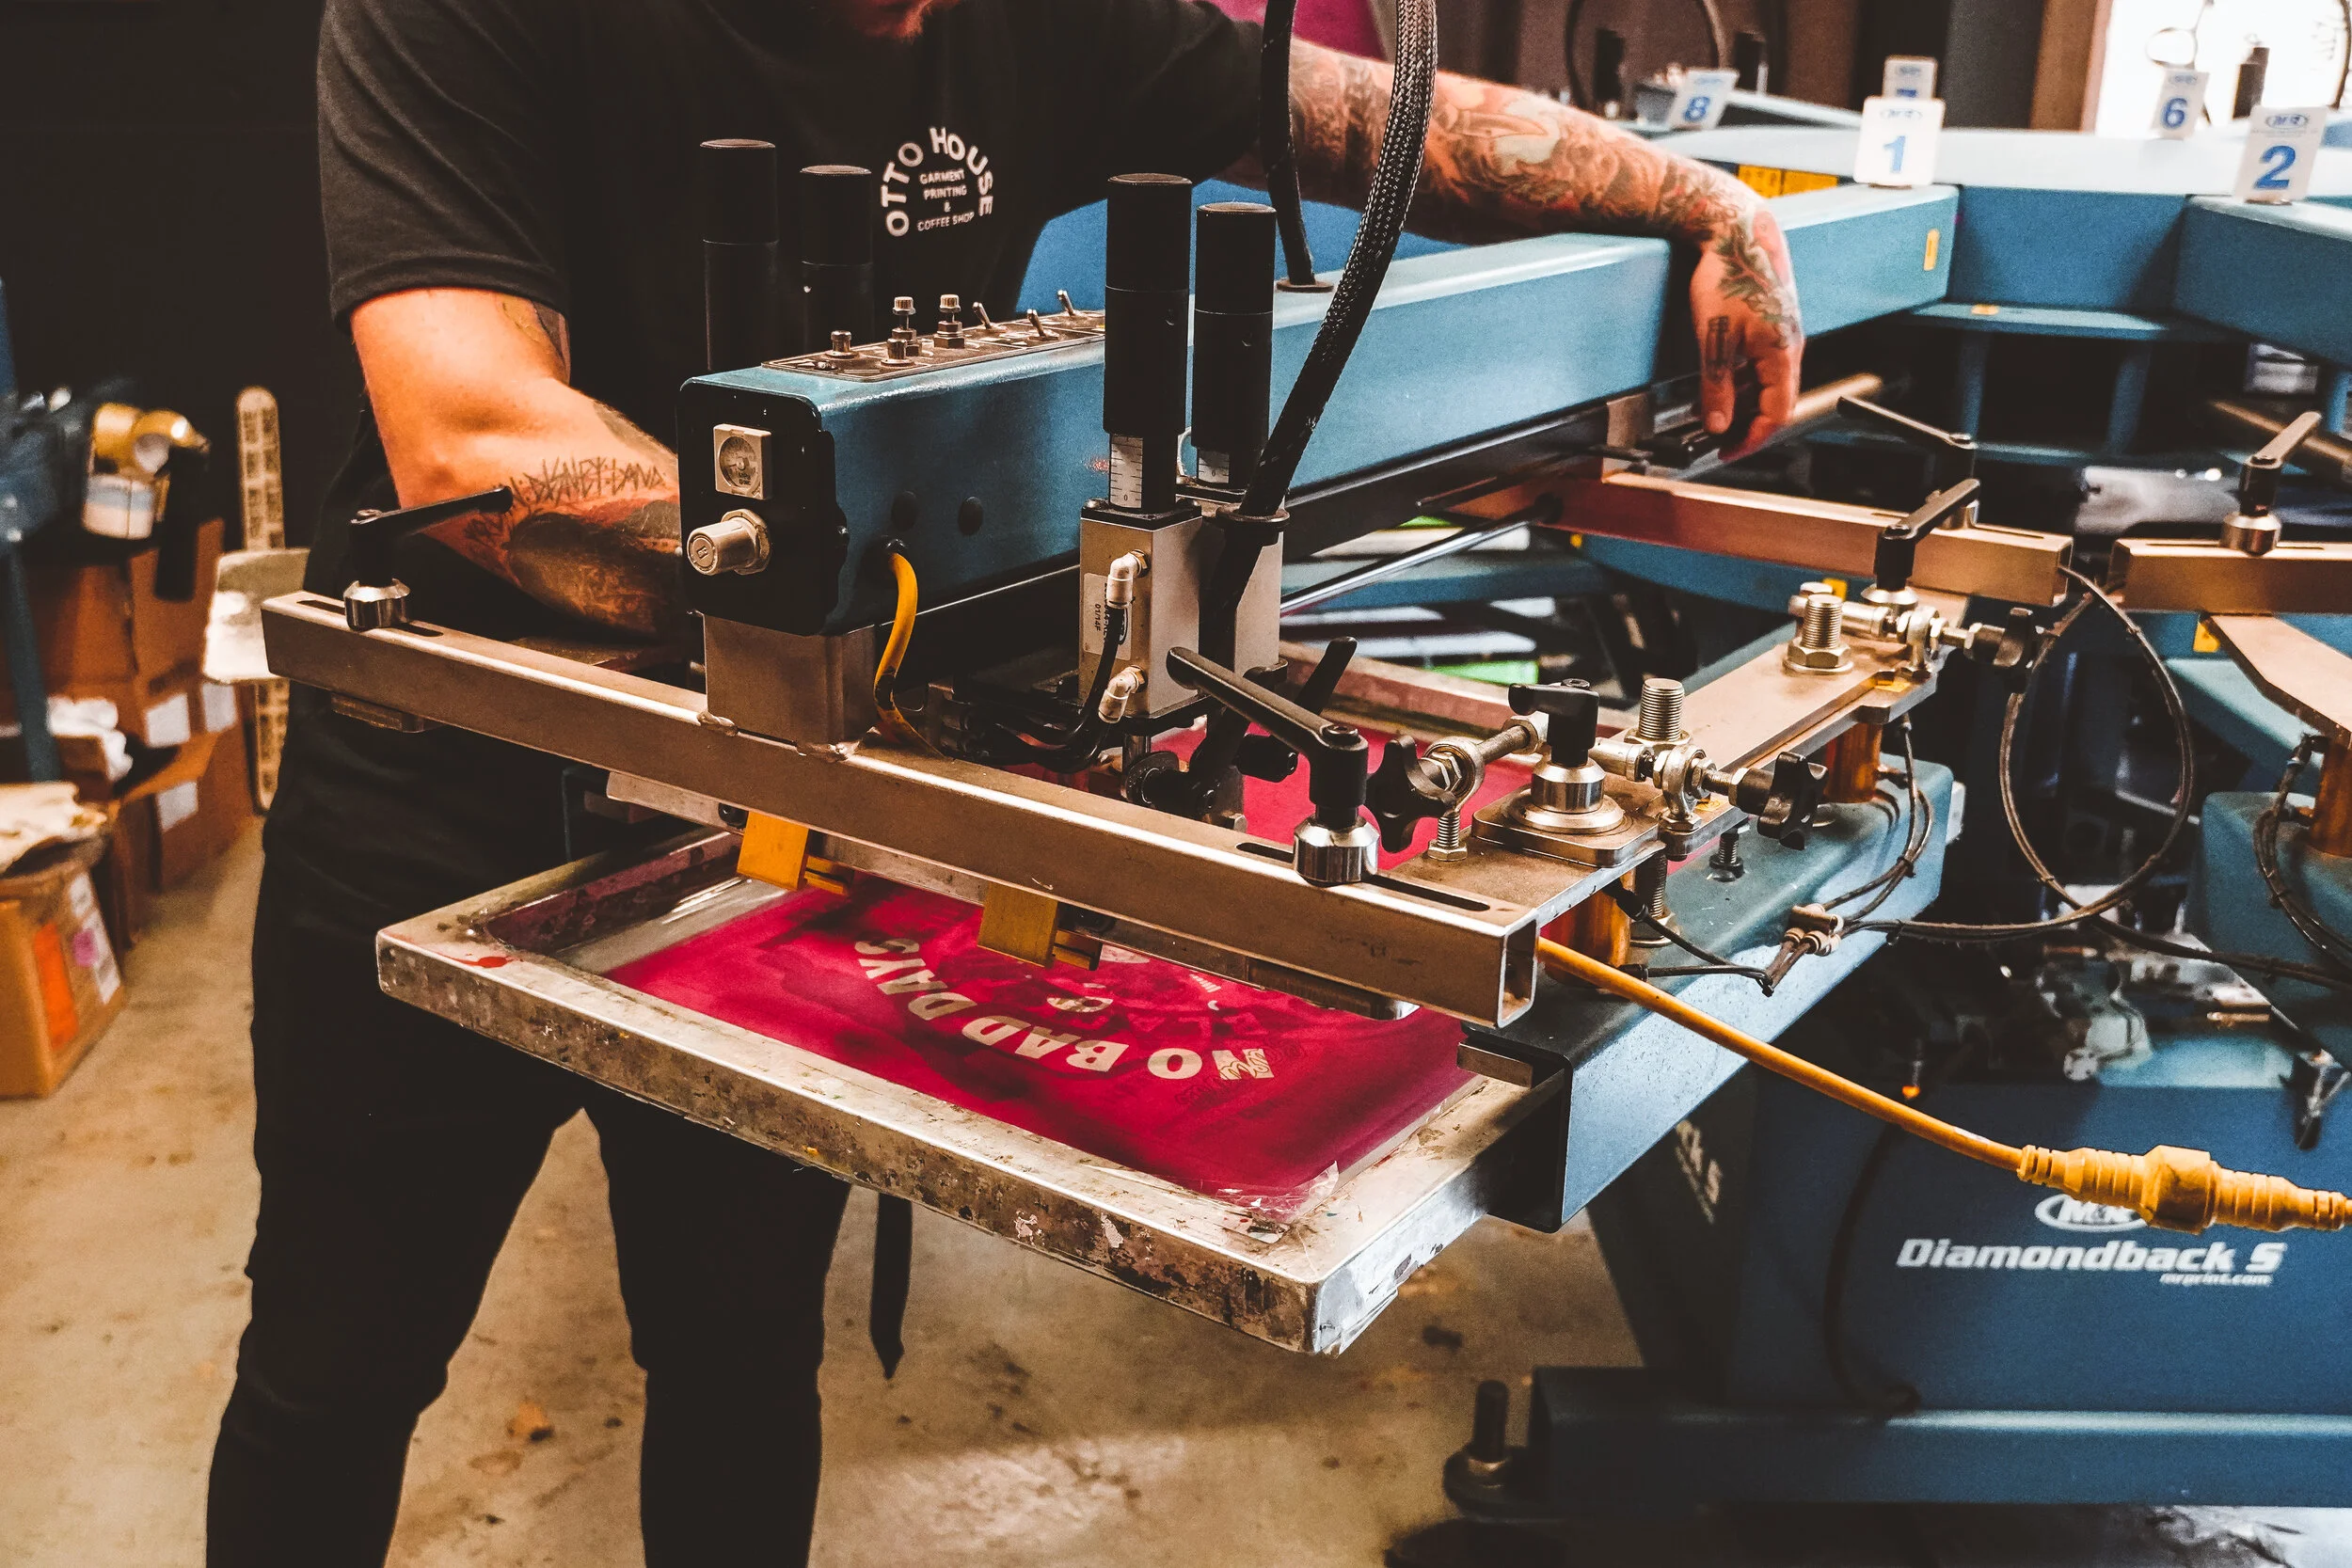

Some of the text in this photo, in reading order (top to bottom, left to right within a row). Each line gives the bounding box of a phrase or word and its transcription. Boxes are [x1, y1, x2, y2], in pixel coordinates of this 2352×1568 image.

[1684, 96, 1710, 122] 8
[2162, 97, 2187, 130] 6
[1883, 135, 1906, 172] 1
[2253, 145, 2296, 190] 2
[881, 126, 993, 237] OTTO HOUSE
[919, 167, 965, 184] GARMENT
[923, 184, 967, 200] PRINTING
[917, 211, 975, 231] COFFEE SHOP
[944, 200, 952, 213] &
[854, 938, 977, 1021] DAYS
[961, 1016, 1129, 1072] BAD
[1147, 1047, 1274, 1080] NO
[1897, 1238, 2286, 1273] Diamondback S
